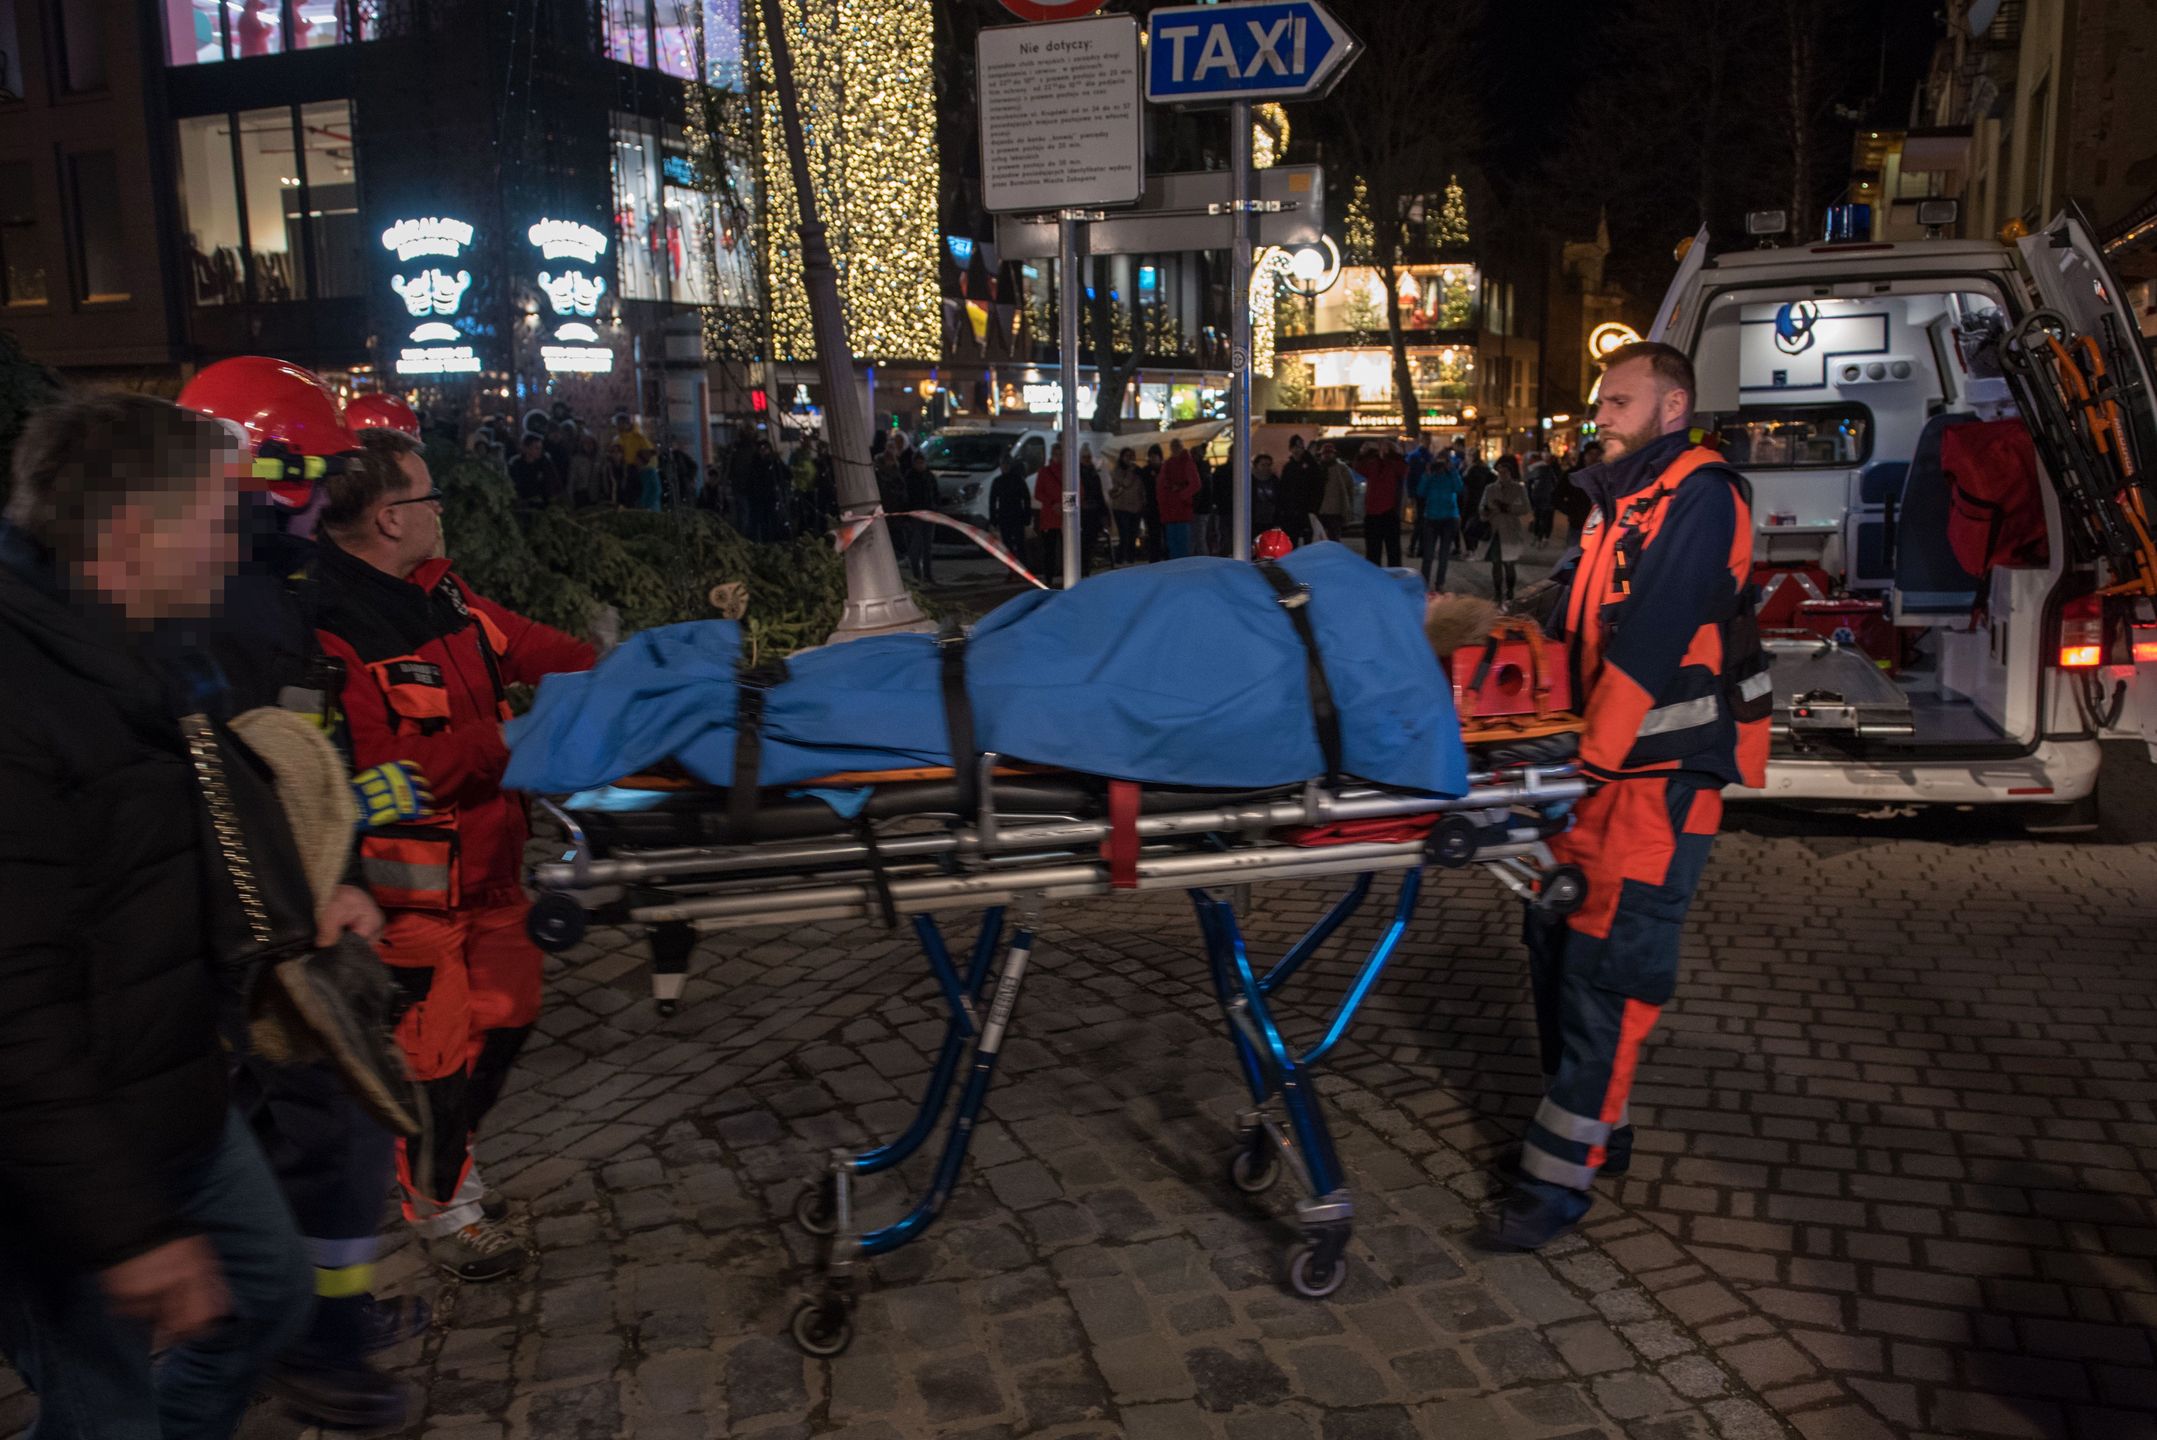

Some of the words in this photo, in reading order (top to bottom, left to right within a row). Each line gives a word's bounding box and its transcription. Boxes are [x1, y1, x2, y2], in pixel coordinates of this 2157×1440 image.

[1020, 43, 1039, 54] Nie
[1046, 38, 1093, 54] dotyczy:
[1160, 17, 1307, 82] TAXI
